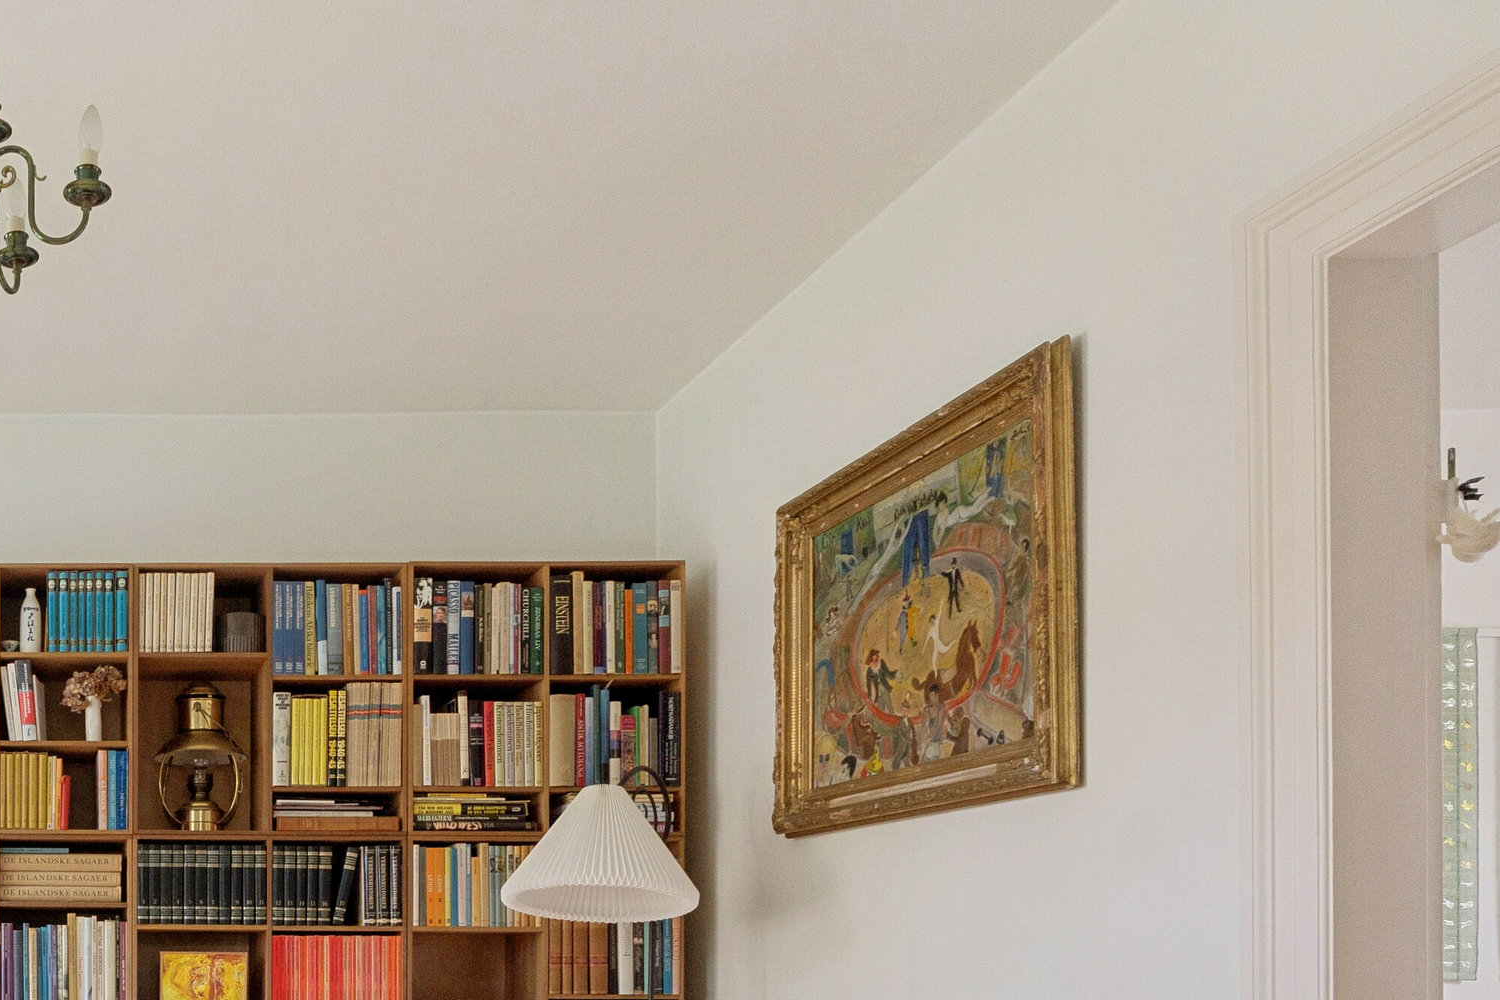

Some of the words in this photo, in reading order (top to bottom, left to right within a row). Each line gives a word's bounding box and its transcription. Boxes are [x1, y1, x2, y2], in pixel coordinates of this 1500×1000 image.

[449, 582, 459, 614] PICASSO
[556, 595, 569, 633] EINSTEIN
[329, 691, 337, 737] BESÆTTELSEN
[338, 691, 346, 738] BESÆTTELSEN
[505, 705, 513, 752] Jødedommen
[535, 705, 543, 730] Japans
[535, 730, 543, 764] religioner
[433, 822, 457, 830] WILD
[459, 822, 482, 830] WEST
[17, 856, 70, 865] ISLANDSKE
[73, 856, 109, 865] SAGAER
[3, 889, 15, 897] DE
[17, 889, 70, 897] ISLANDSKE
[72, 889, 109, 897] SAGAER
[17, 873, 69, 882] ISLANDSKE
[72, 873, 108, 882] SAGAER
